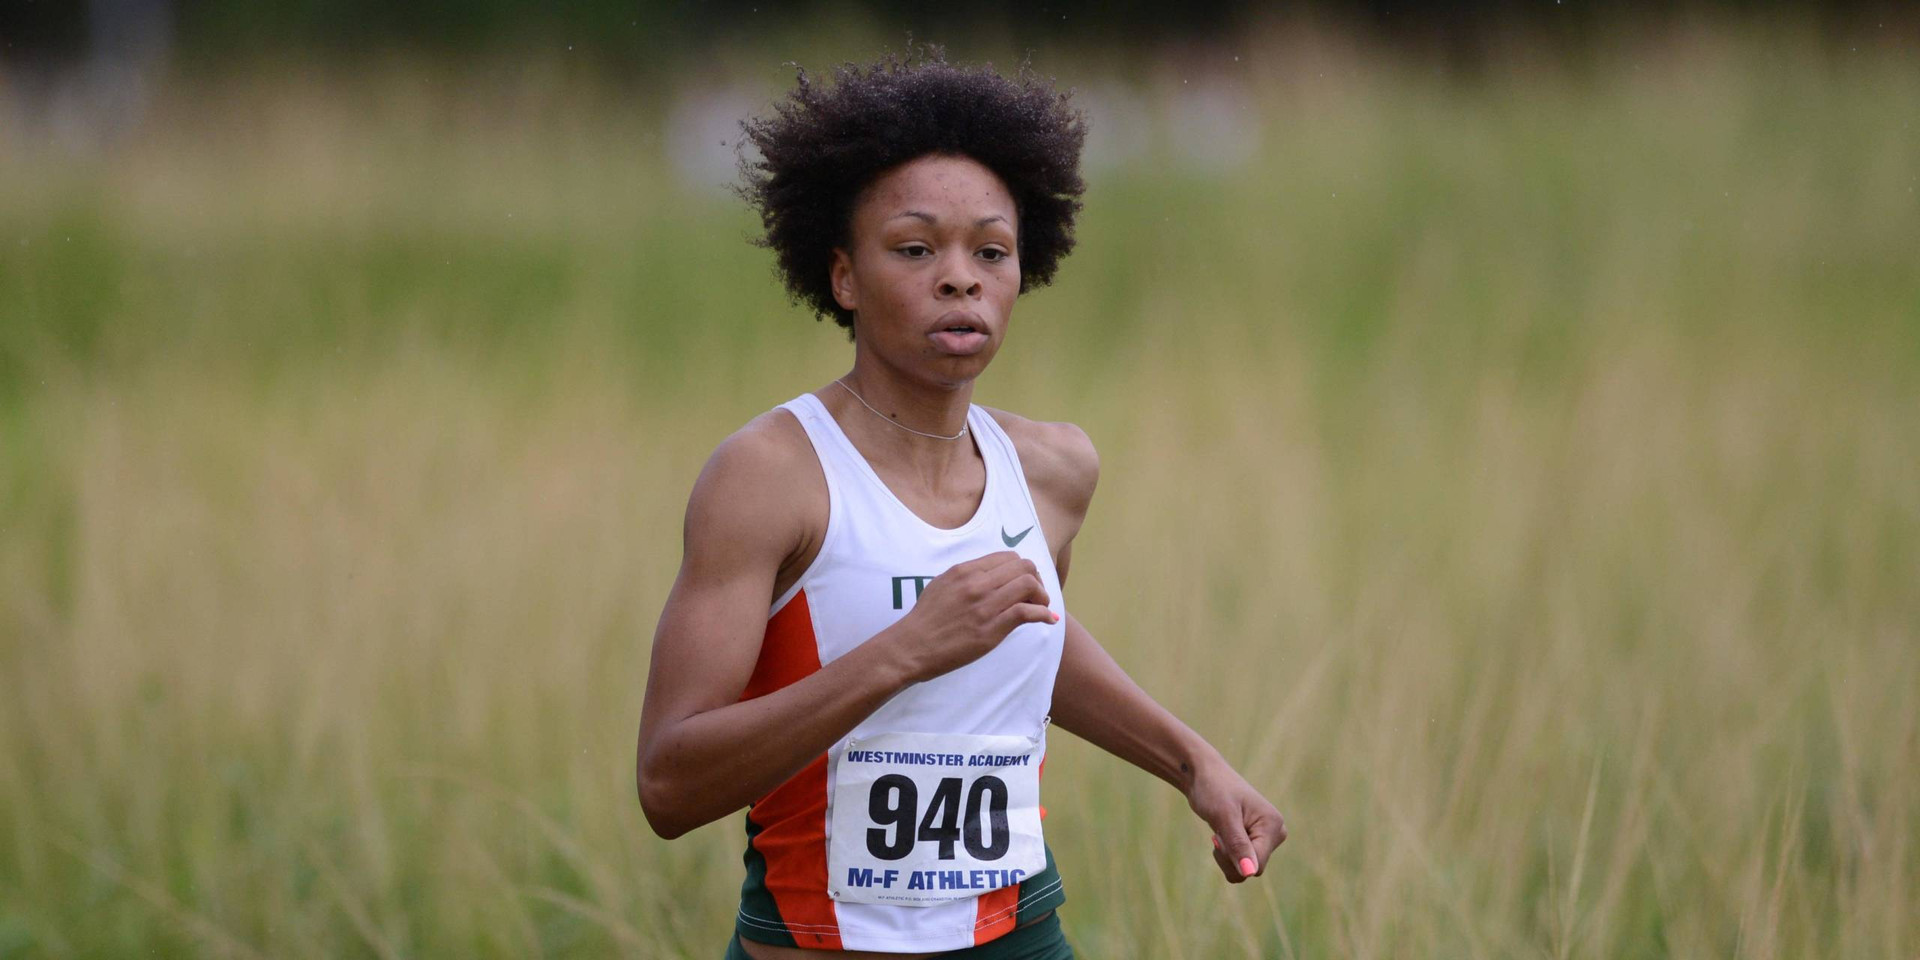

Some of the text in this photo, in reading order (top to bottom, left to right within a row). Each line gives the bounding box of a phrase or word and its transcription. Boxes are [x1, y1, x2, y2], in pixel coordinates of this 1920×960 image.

[848, 751, 1030, 766] WESTMINSTER ACADEMY
[866, 774, 1010, 861] 940
[847, 868, 899, 888] M-F
